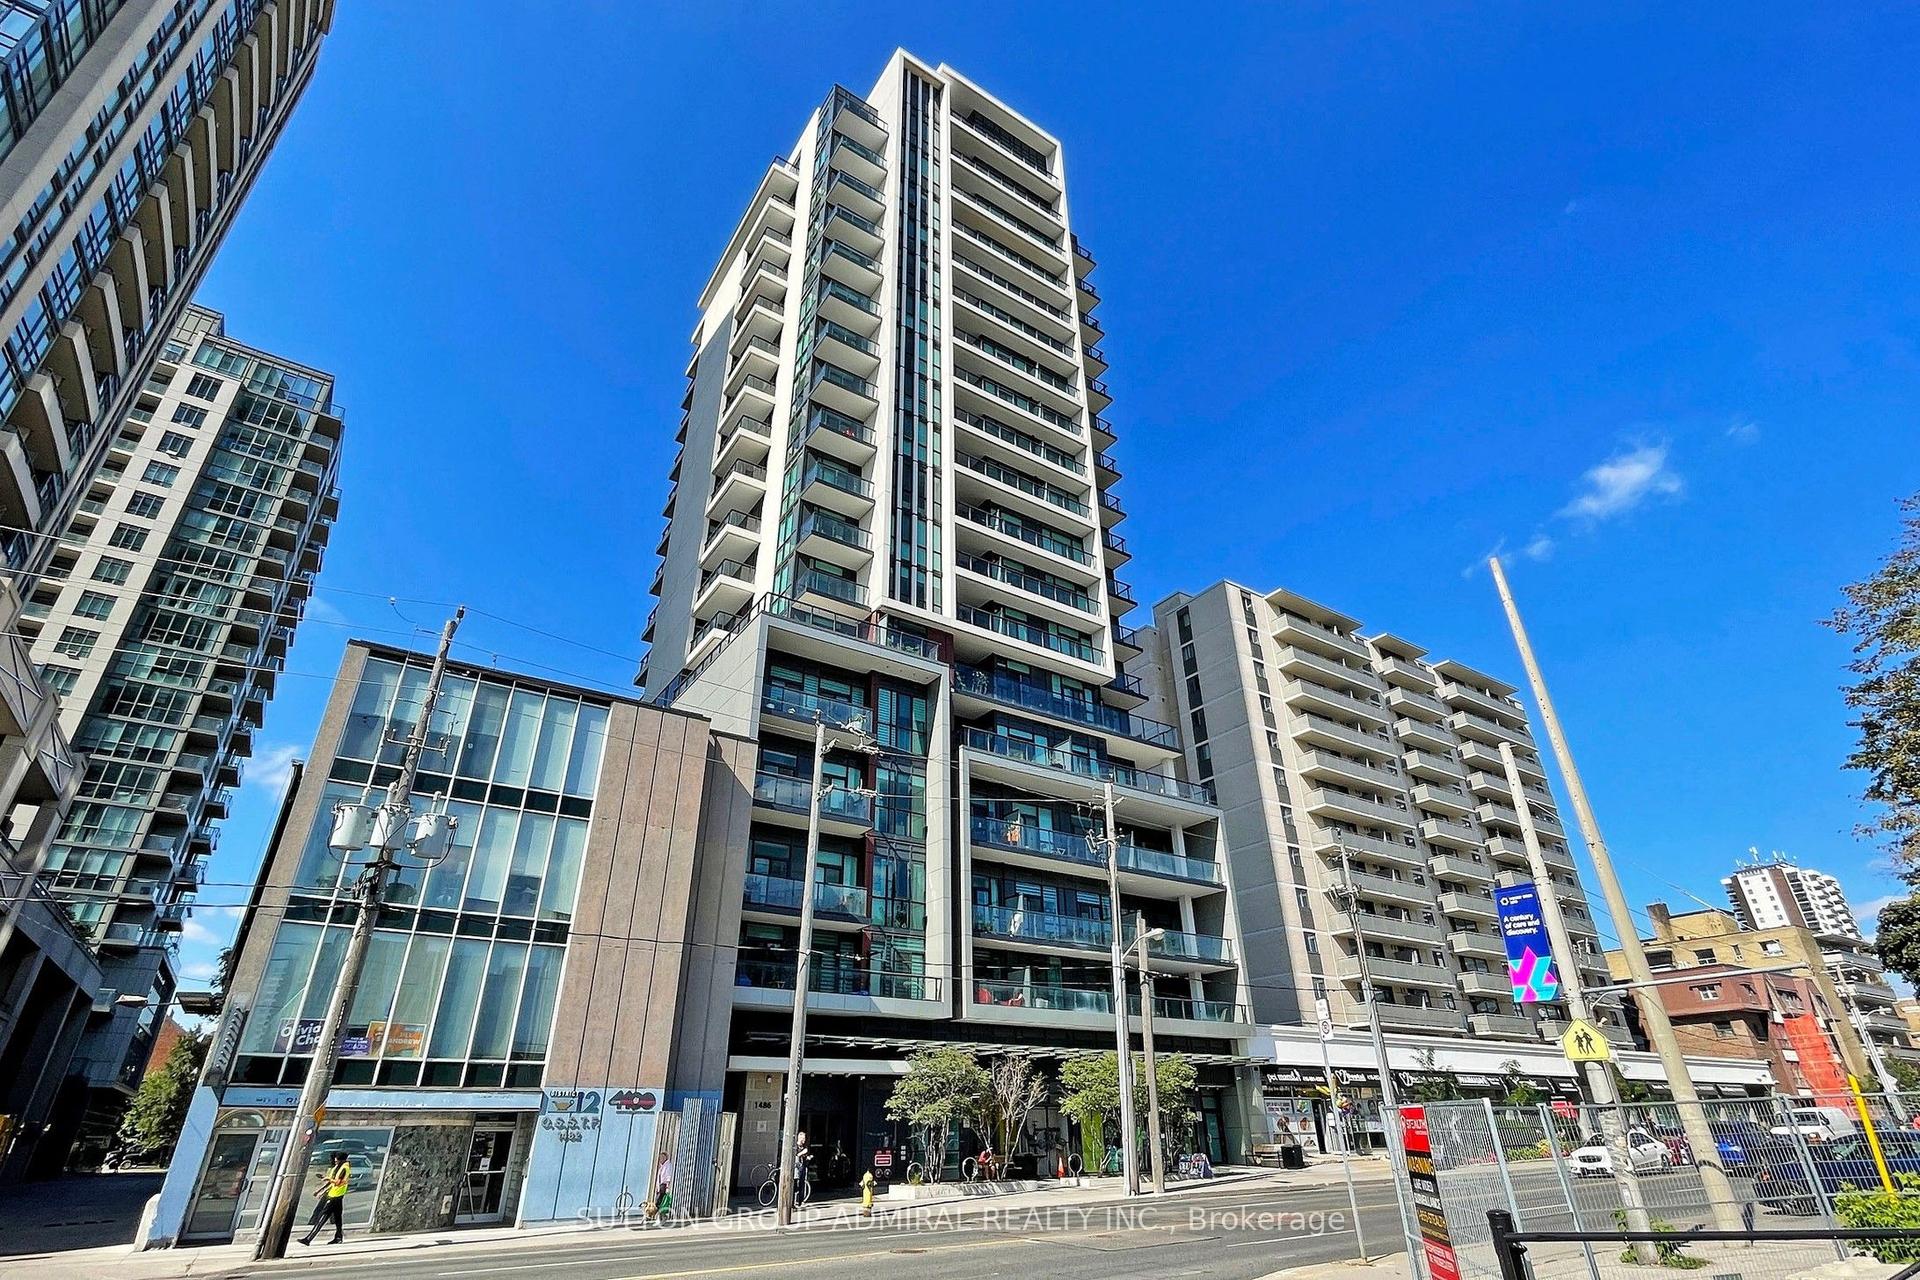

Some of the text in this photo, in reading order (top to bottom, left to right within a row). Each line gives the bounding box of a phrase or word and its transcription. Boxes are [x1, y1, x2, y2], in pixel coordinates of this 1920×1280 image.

[1503, 914, 1535, 923] A century
[1504, 922, 1512, 930] of
[1527, 918, 1541, 926] and
[280, 1023, 322, 1037] Oivia
[576, 1091, 601, 1114] 12
[754, 1101, 772, 1109] 1486
[1407, 1156, 1434, 1176] WARNING
